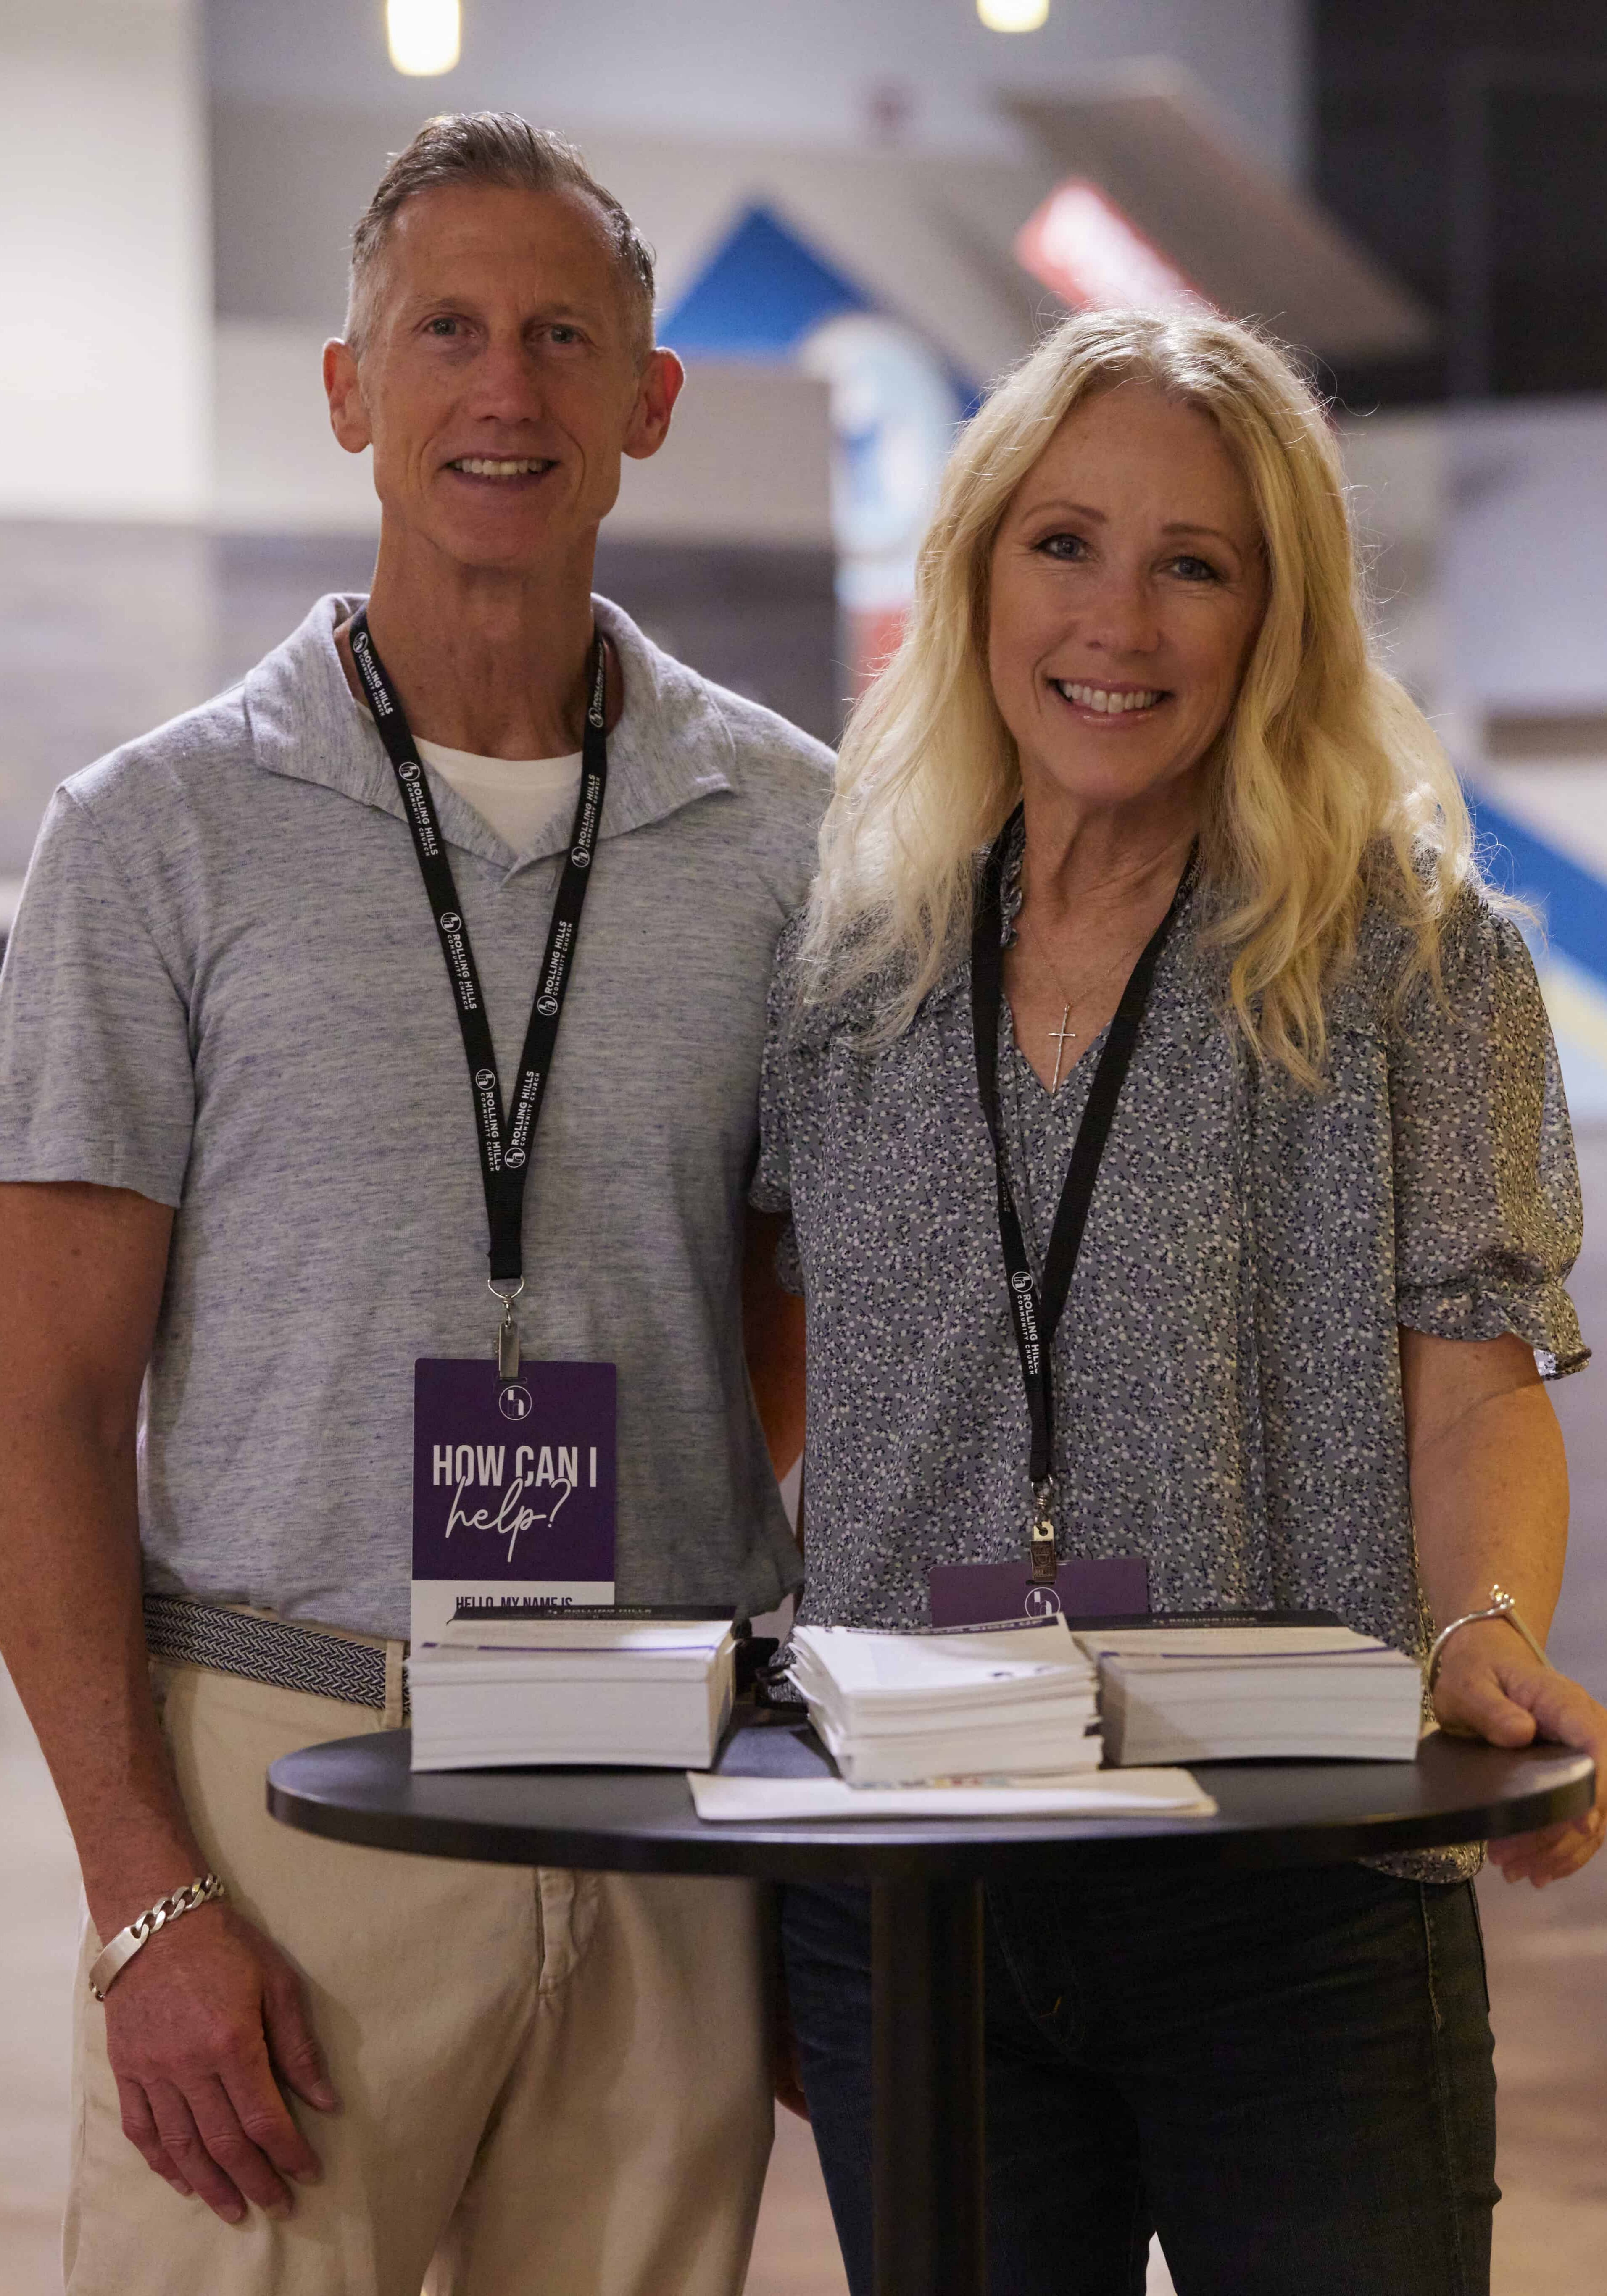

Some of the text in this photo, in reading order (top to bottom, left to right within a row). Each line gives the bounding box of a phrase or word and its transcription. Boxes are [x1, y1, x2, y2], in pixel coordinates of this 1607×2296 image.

[362, 650, 393, 714] ROLLING HILLS
[406, 783, 430, 856] COMMUNITY CHURCH
[412, 782, 438, 855] ROLLING HILLS
[579, 774, 597, 846] ROLLING HILLS
[448, 935, 469, 1009] COMMUNITY CHURCH
[453, 934, 477, 1009] ROLLING HILLS
[545, 921, 566, 994] ROLLING HILLS
[553, 924, 572, 995] COMMUNITY CHURCH
[481, 1093, 490, 1137] COMMUNITY
[486, 1092, 498, 1137] ROLLING
[511, 1071, 534, 1145] ROLLING HILLS
[520, 1073, 540, 1146] COMMUNITY CHURCH
[1017, 1295, 1034, 1374] COMMUNITY CHURCH
[1023, 1294, 1038, 1341] ROLLING
[433, 1445, 597, 1487] HOW CAN I
[445, 1475, 571, 1562] help?
